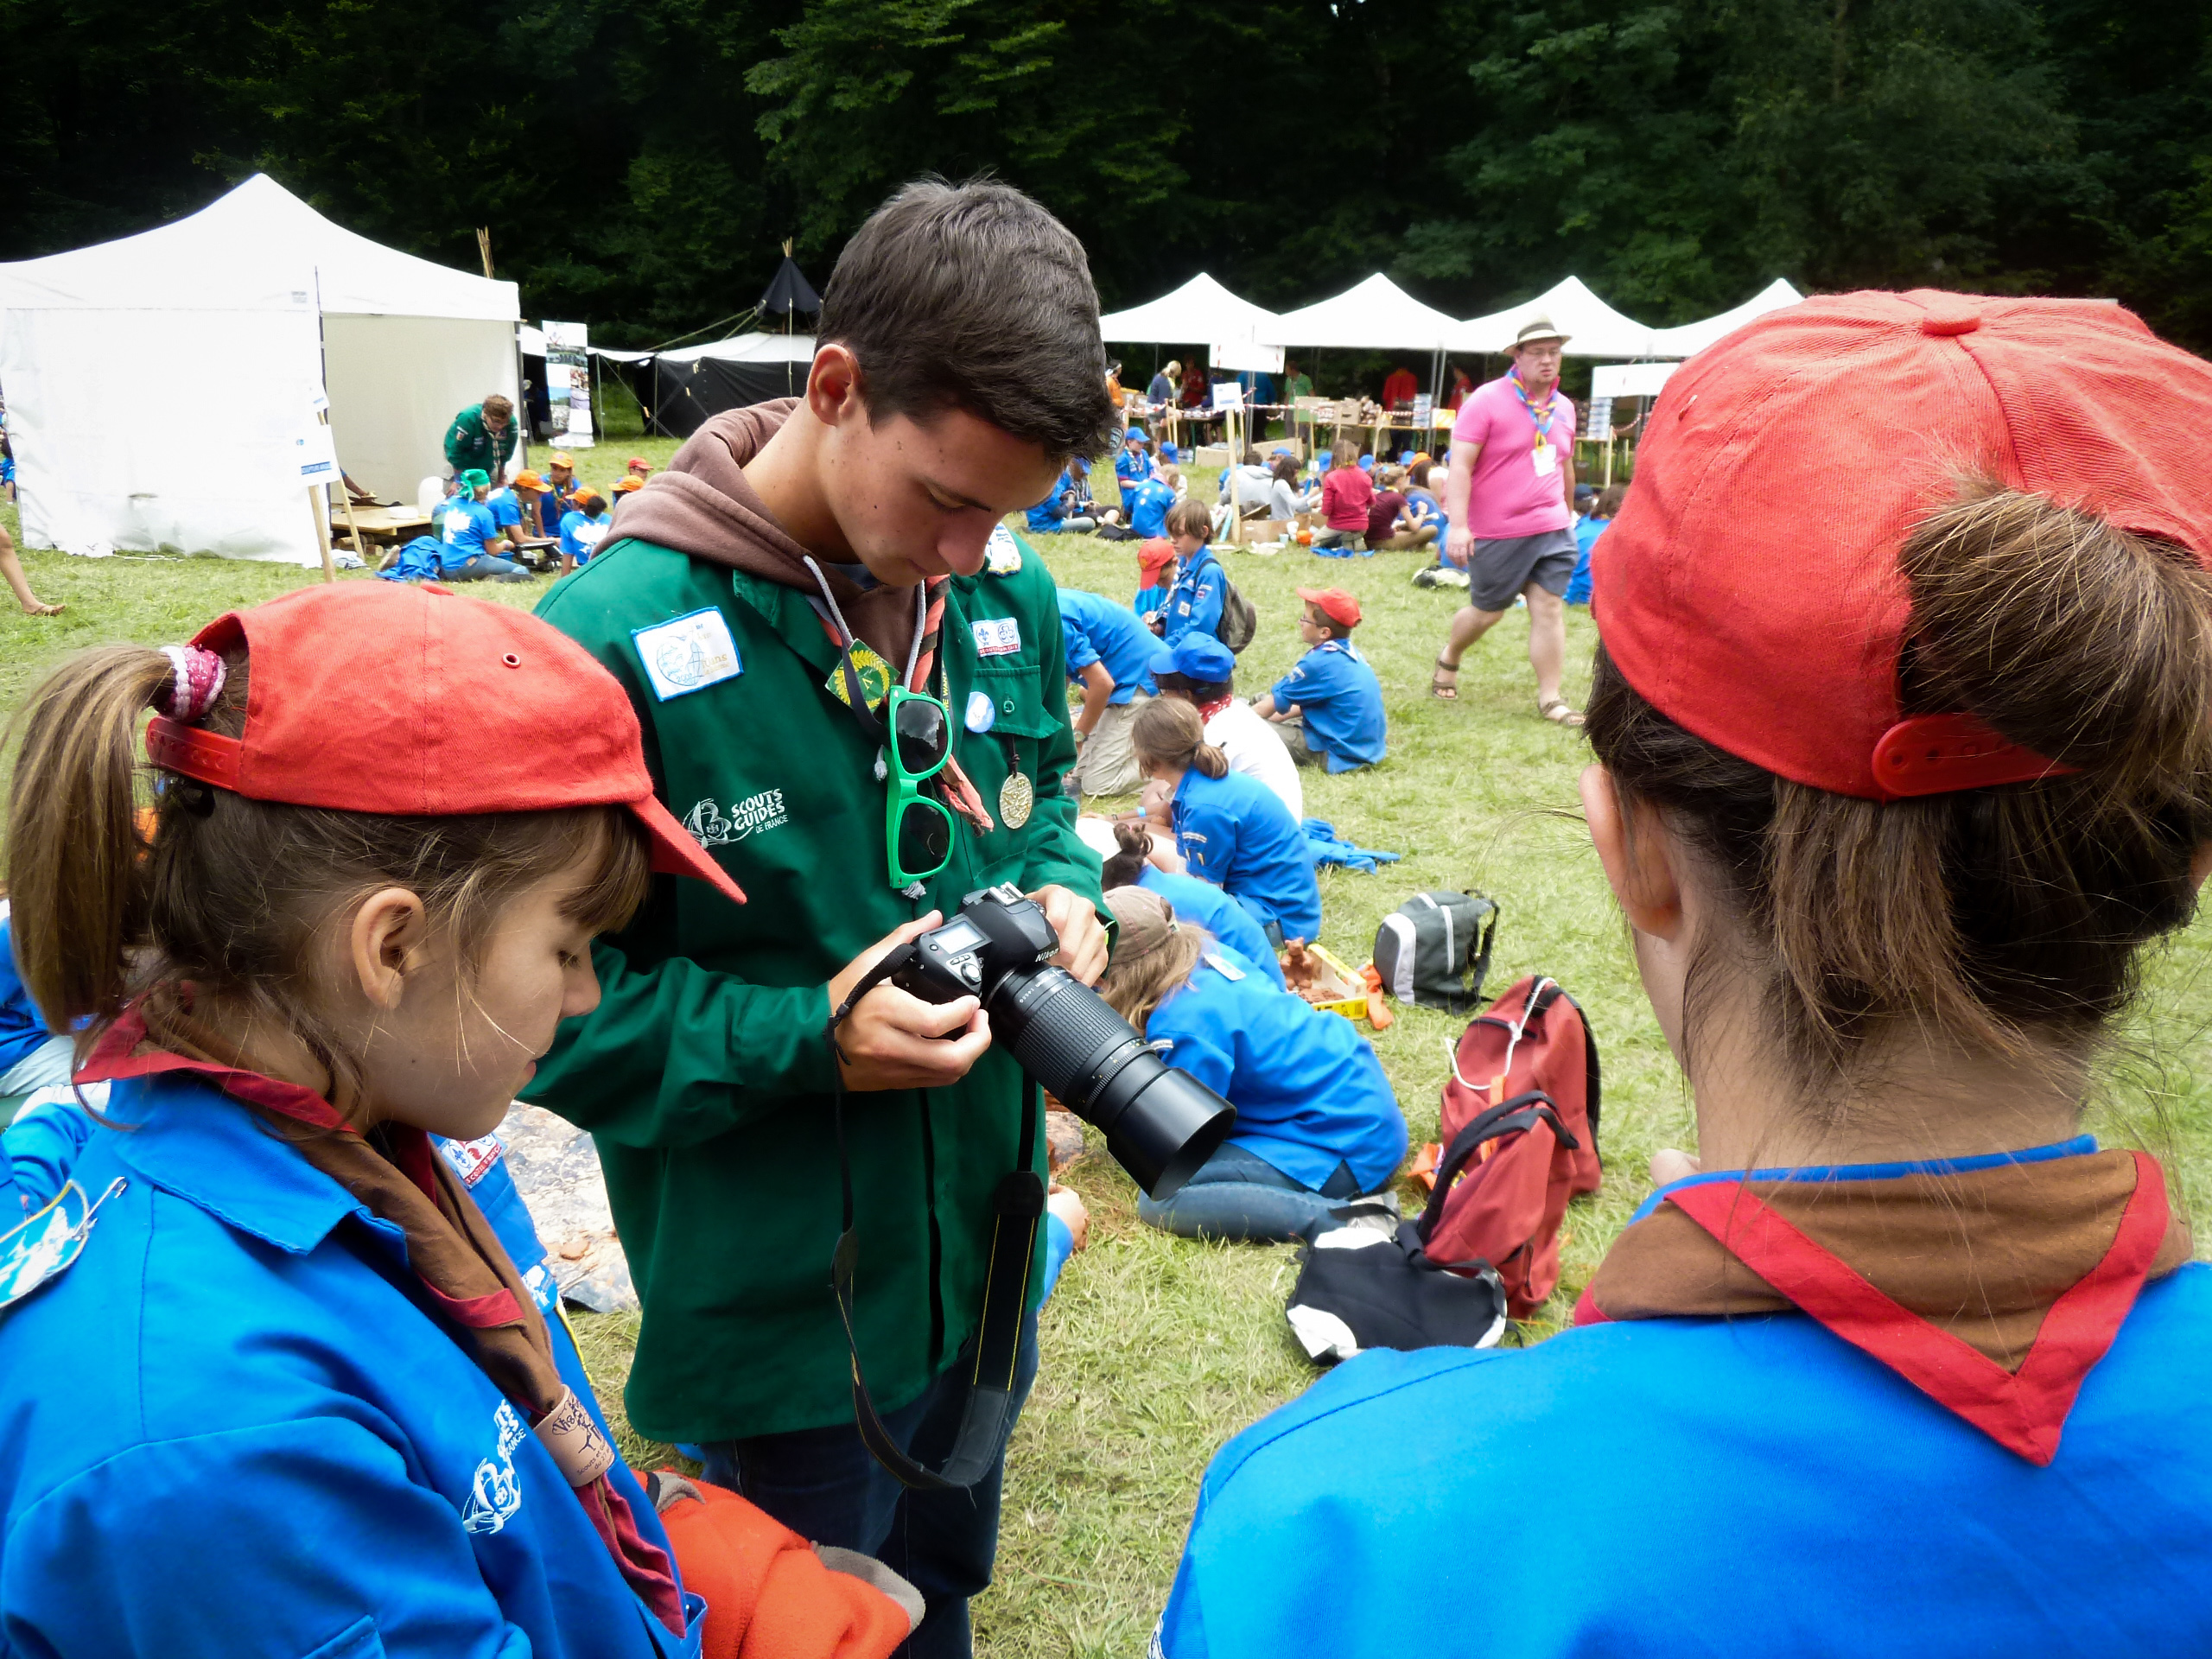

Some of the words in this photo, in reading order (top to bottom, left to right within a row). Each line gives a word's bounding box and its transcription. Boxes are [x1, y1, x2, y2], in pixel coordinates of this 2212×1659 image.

[731, 788, 783, 818] SCOUTS
[734, 801, 785, 830] GUIDES
[755, 824, 765, 834] DE
[765, 815, 788, 830] FRANCE
[1034, 947, 1059, 963] Nikon
[577, 1458, 596, 1475] Scouts
[594, 1460, 602, 1470] du
